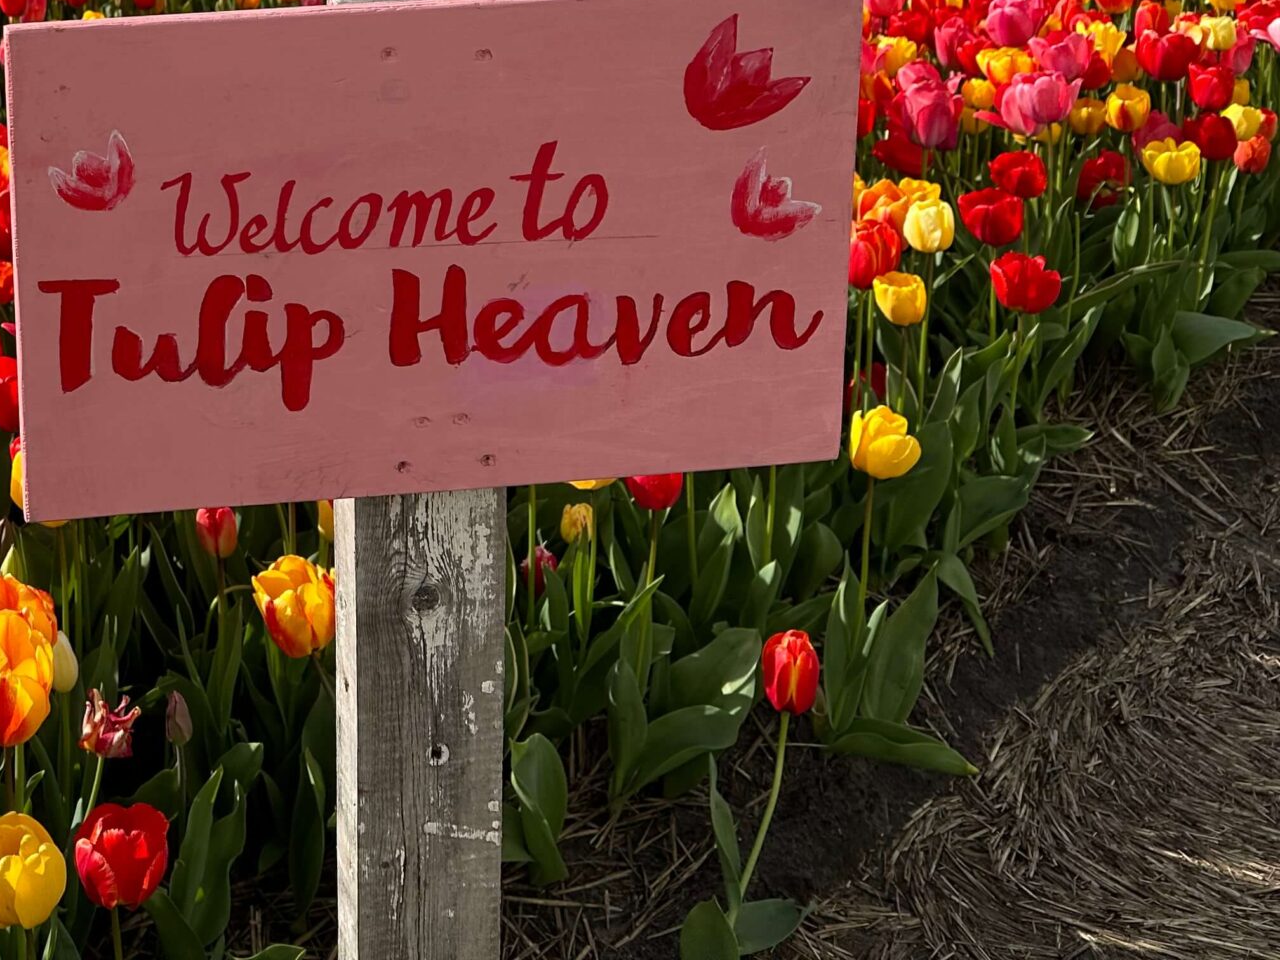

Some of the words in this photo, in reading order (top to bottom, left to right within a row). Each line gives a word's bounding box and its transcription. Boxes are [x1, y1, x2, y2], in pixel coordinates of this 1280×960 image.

[160, 171, 497, 256] Welcome
[509, 140, 609, 242] to
[37, 274, 346, 412] Tulip
[389, 264, 824, 367] Heaven
